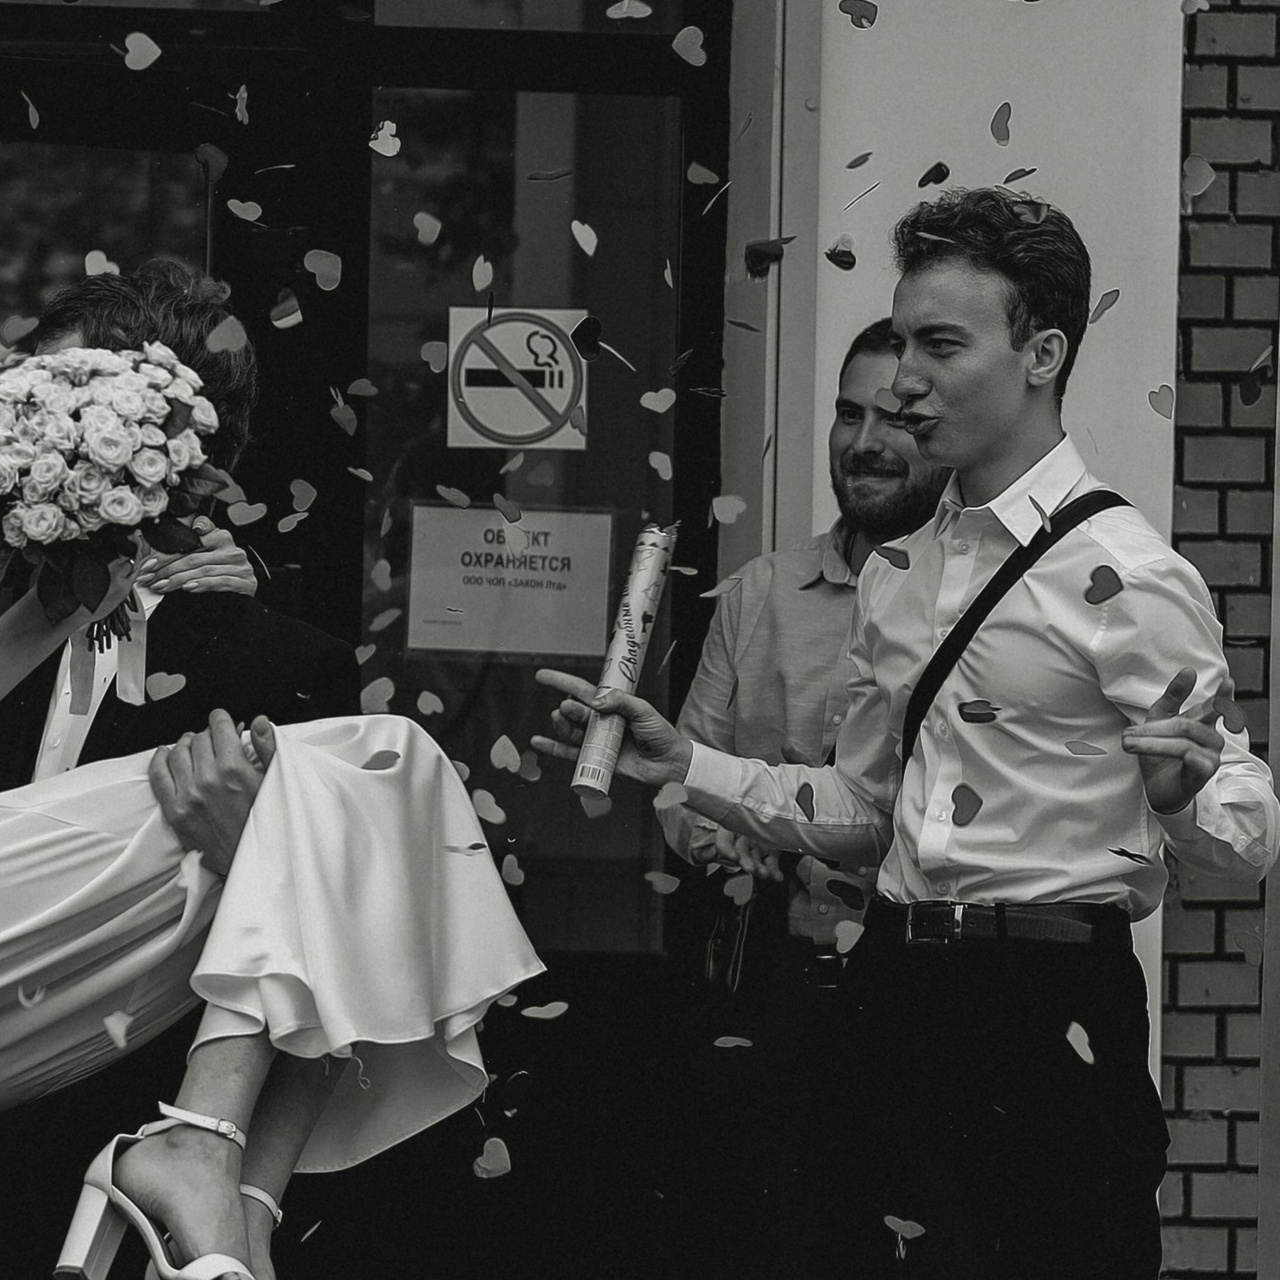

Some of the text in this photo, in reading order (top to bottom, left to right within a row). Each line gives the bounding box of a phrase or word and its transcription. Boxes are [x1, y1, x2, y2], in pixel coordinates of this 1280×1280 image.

[484, 527, 551, 548] ОБКТ
[461, 550, 571, 572] ОХРАНЯЕТСЯ
[462, 575, 484, 586] ООО
[486, 576, 505, 588] ЧОП
